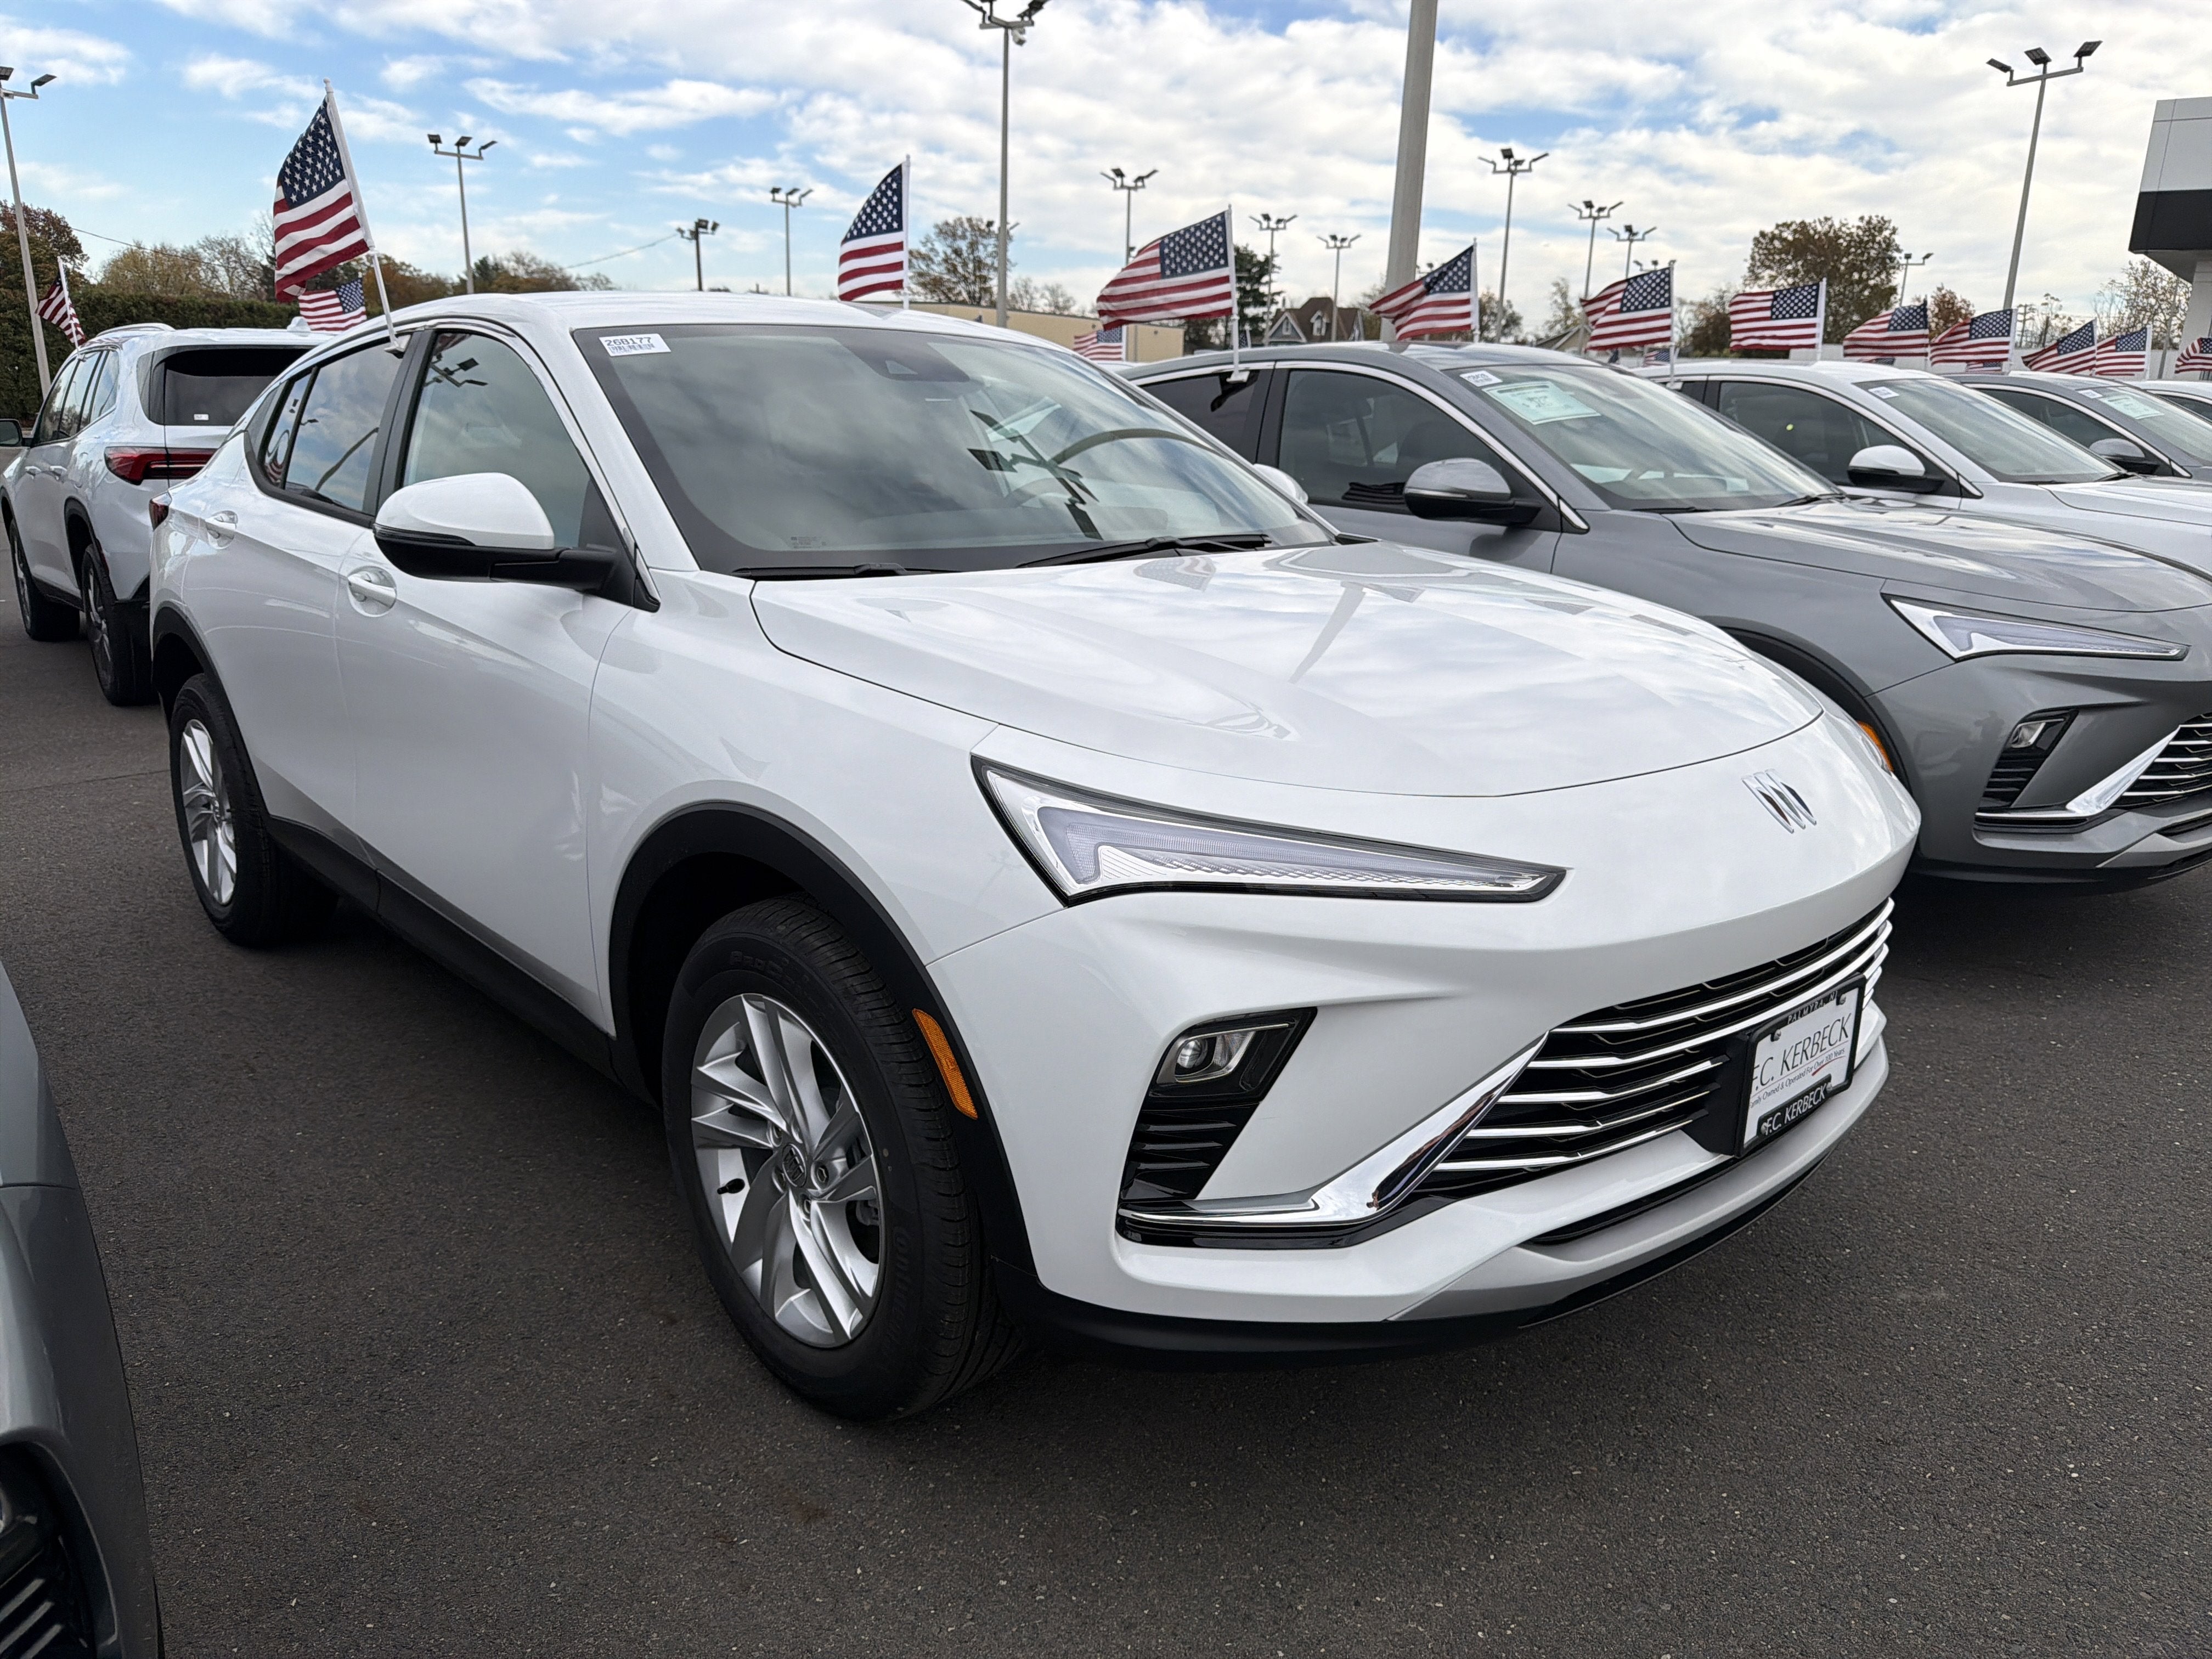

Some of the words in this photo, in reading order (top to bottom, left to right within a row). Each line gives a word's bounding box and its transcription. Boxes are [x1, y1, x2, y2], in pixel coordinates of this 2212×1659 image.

[605, 337, 652, 346] 26B177
[1780, 1013, 1852, 1076] KERBECK
[1750, 1095, 1762, 1109] amily
[1763, 1082, 1780, 1101] Owned
[1785, 1068, 1807, 1087] Operated
[1784, 1082, 1827, 1124] KERBECK
